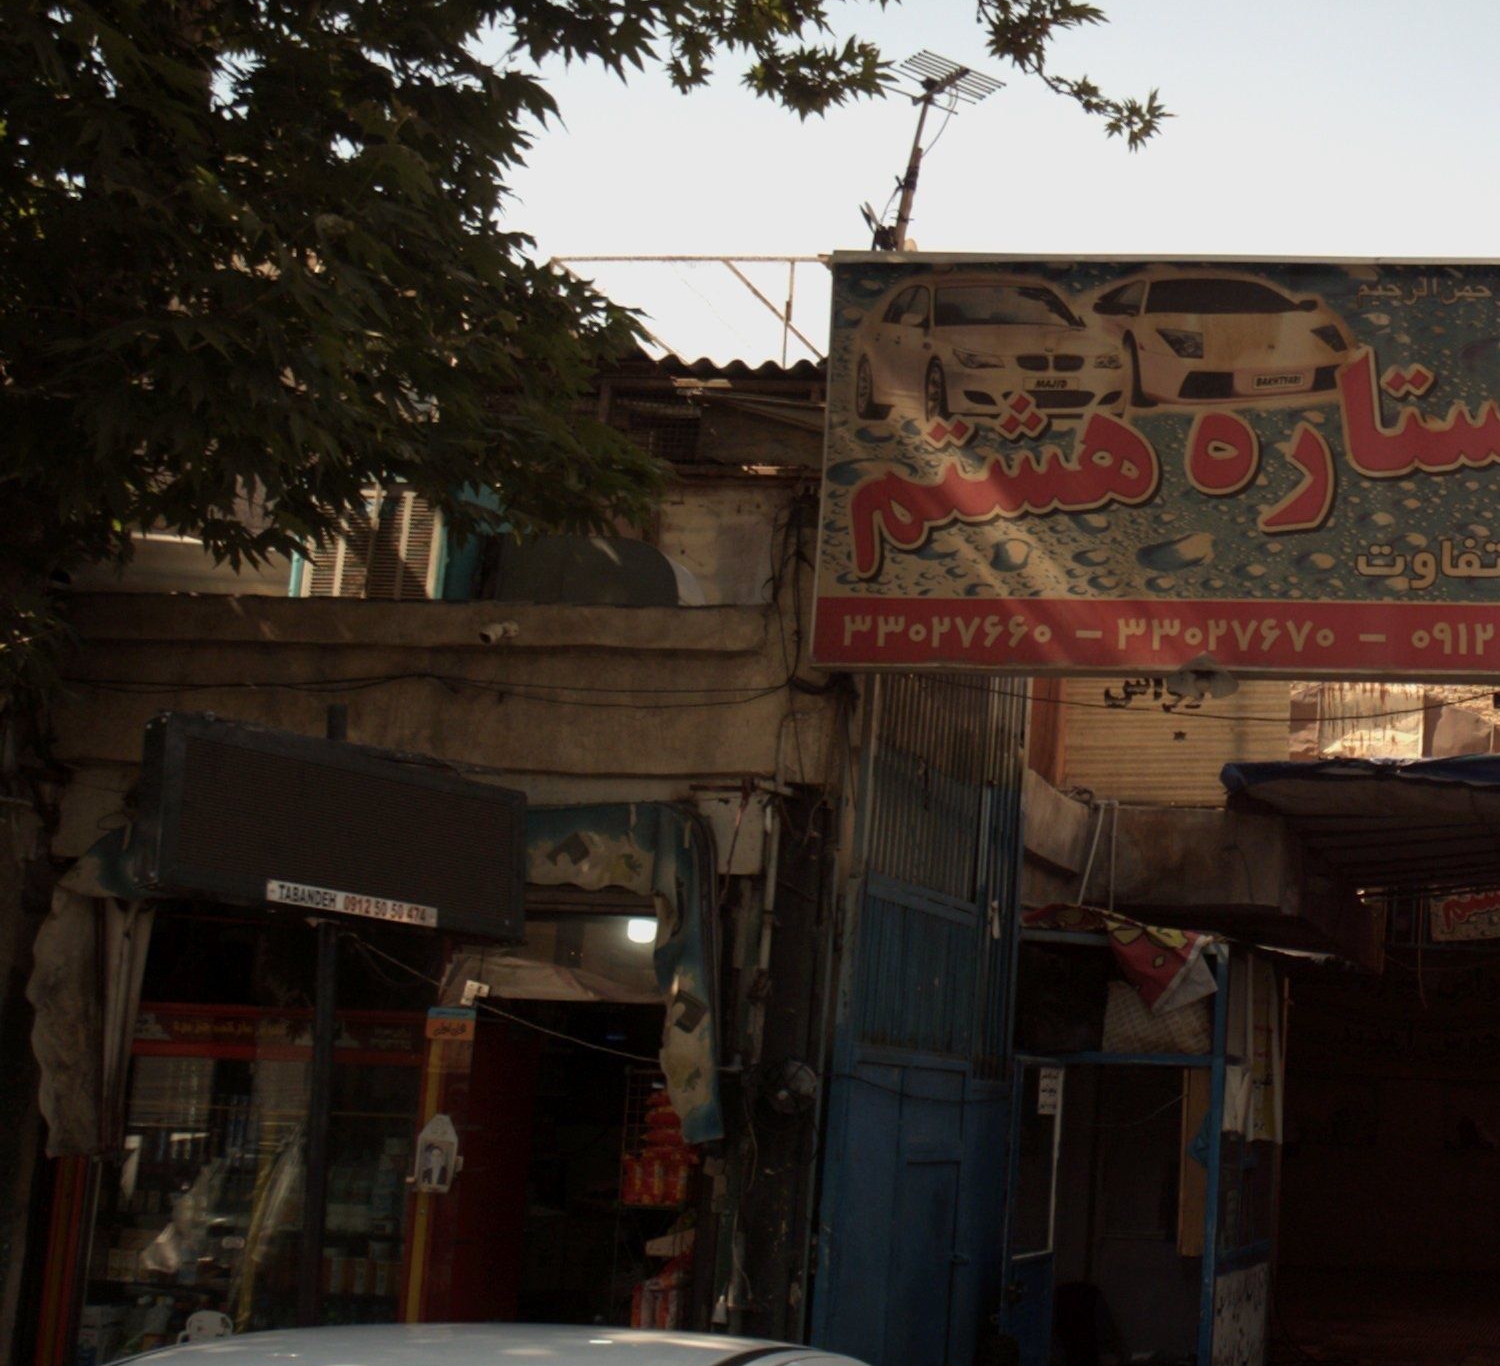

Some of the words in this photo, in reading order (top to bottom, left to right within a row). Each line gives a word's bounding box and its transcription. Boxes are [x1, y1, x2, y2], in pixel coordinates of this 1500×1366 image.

[850, 391, 1159, 580] هشتم
[843, 613, 1053, 649] ۳۳۰۲۷۶۶۰
[1117, 617, 1336, 653] ۳۳۰۲۷۶۷۰
[278, 883, 337, 910] TABANDEH
